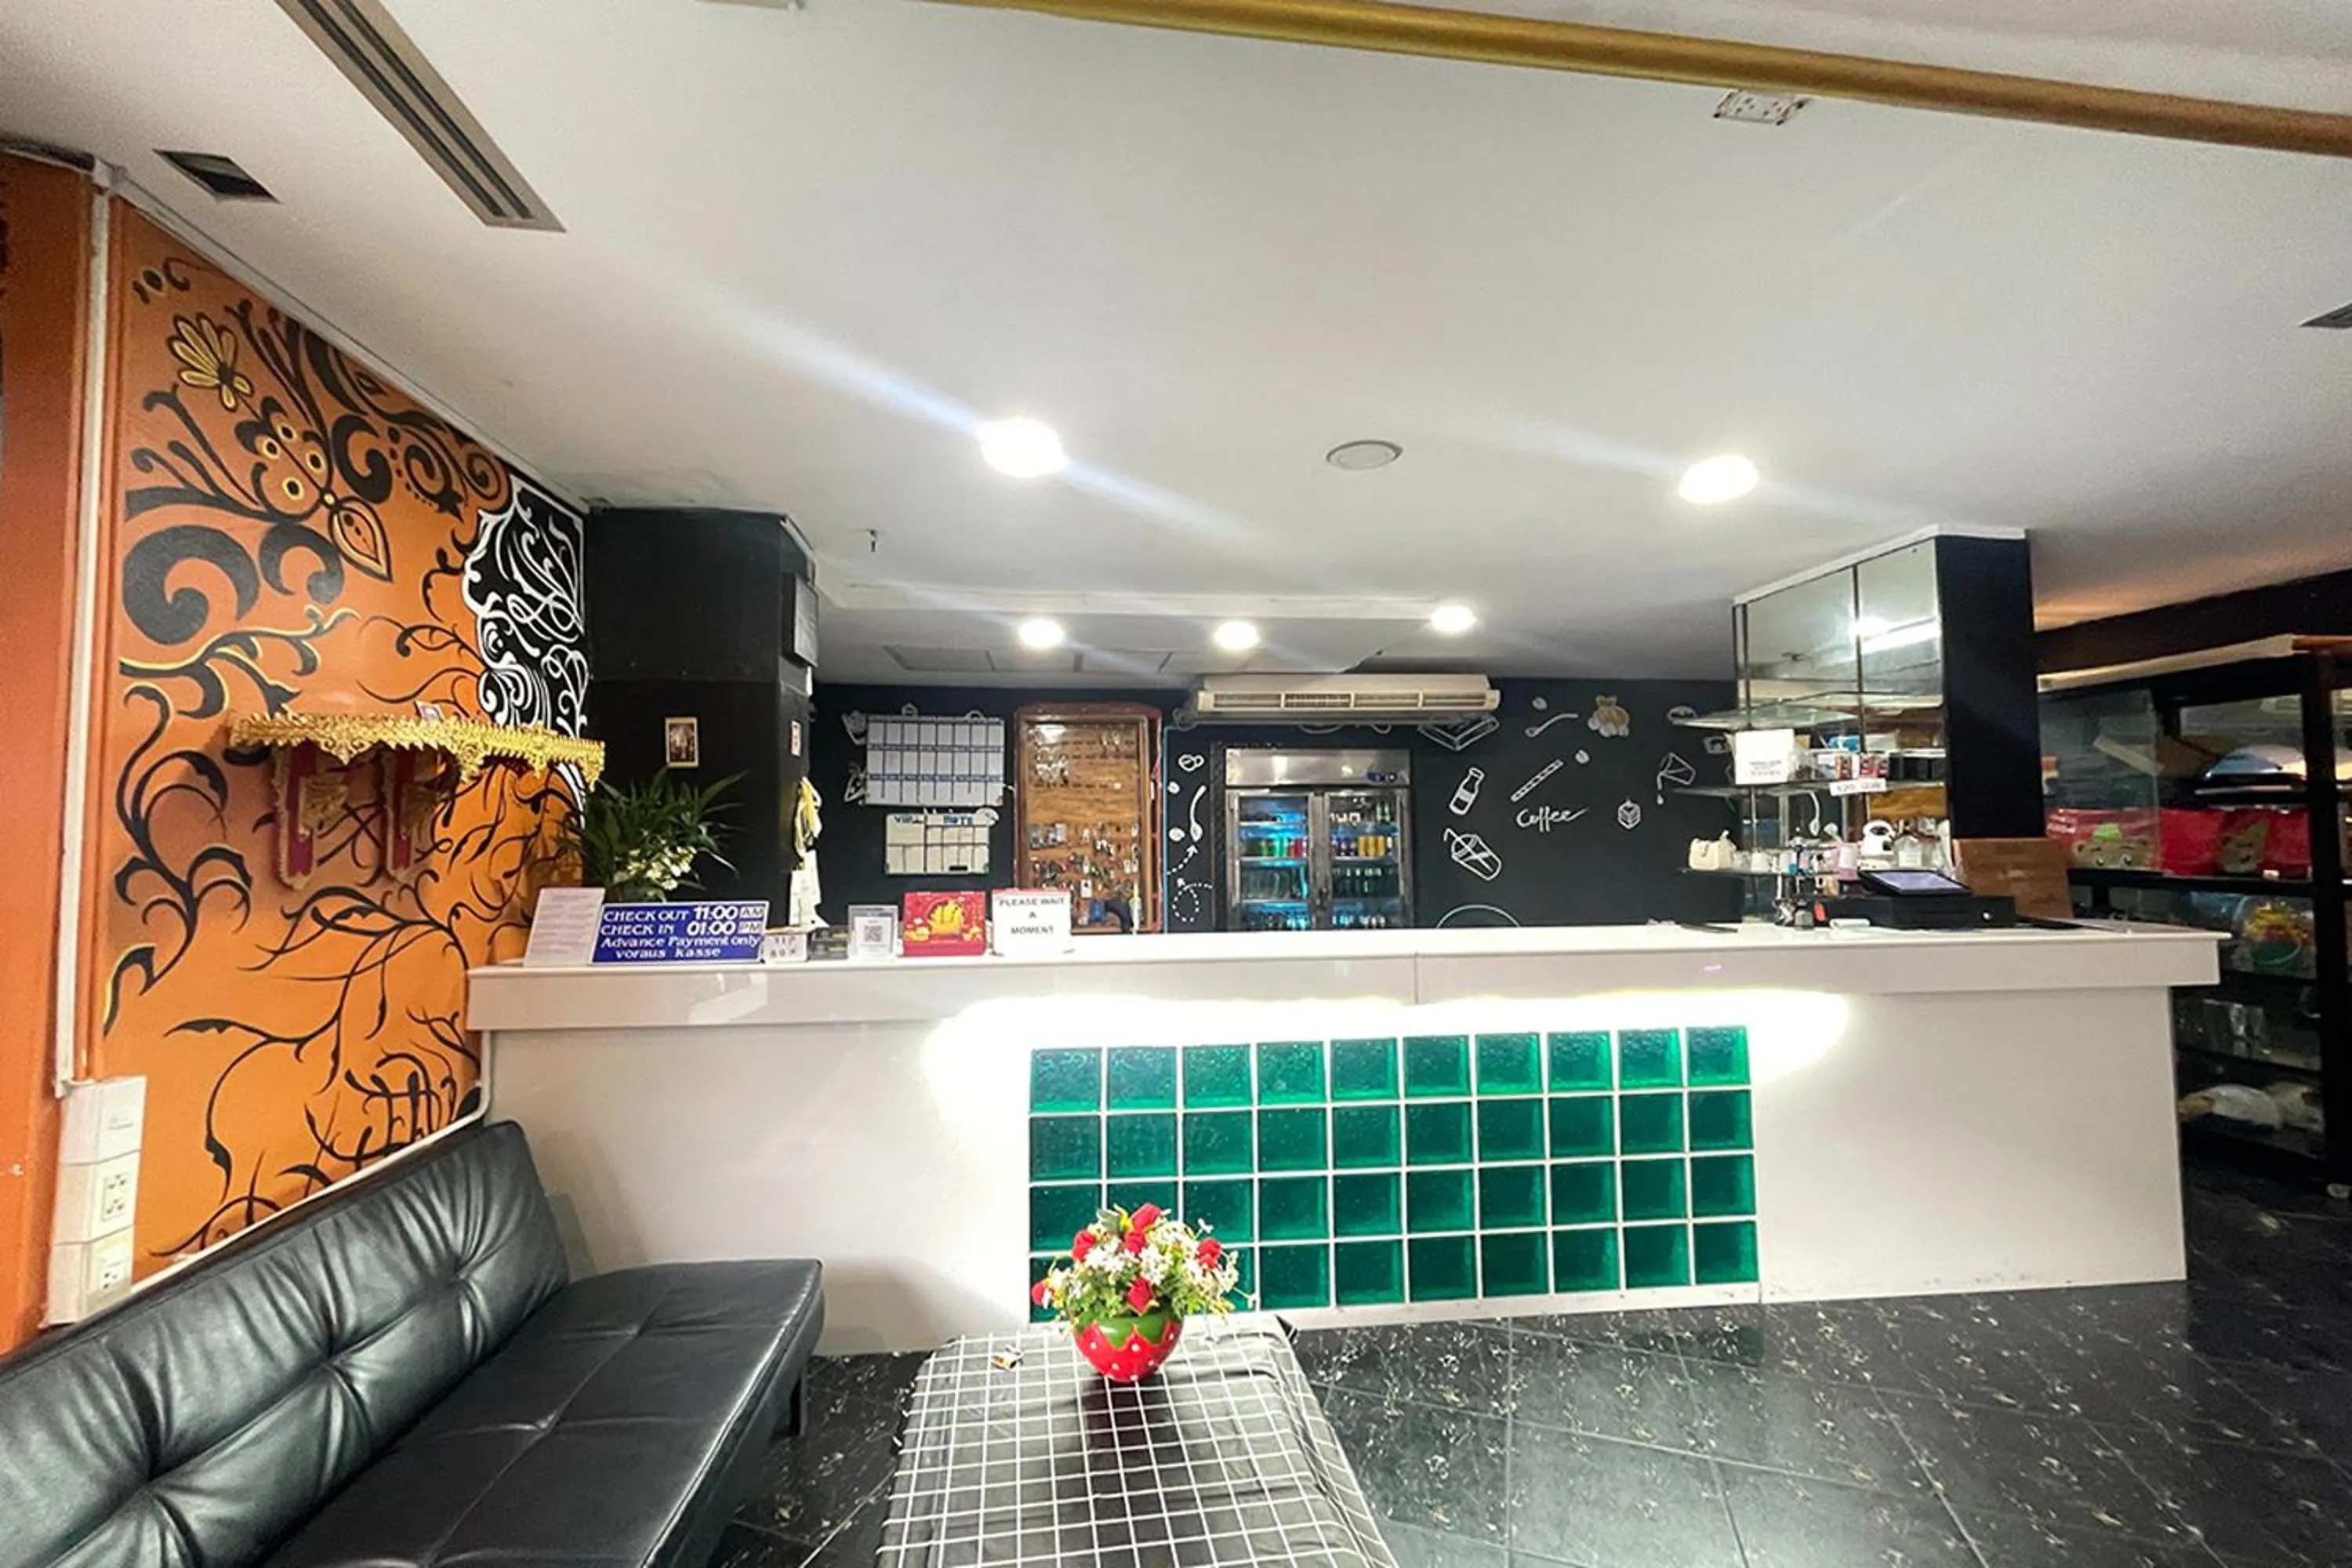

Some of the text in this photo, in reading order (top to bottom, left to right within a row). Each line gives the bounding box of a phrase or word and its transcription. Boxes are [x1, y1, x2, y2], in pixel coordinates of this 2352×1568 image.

[1515, 805, 1590, 833] Coffee
[999, 898, 1038, 906] PLEASE
[604, 910, 656, 922] CHECK
[658, 910, 689, 920] OUT
[601, 924, 654, 935] CHECK
[659, 924, 674, 935] IN
[1011, 925, 1054, 935] MOMENT
[601, 935, 760, 949] Advance Payment only
[615, 949, 666, 959] voraus
